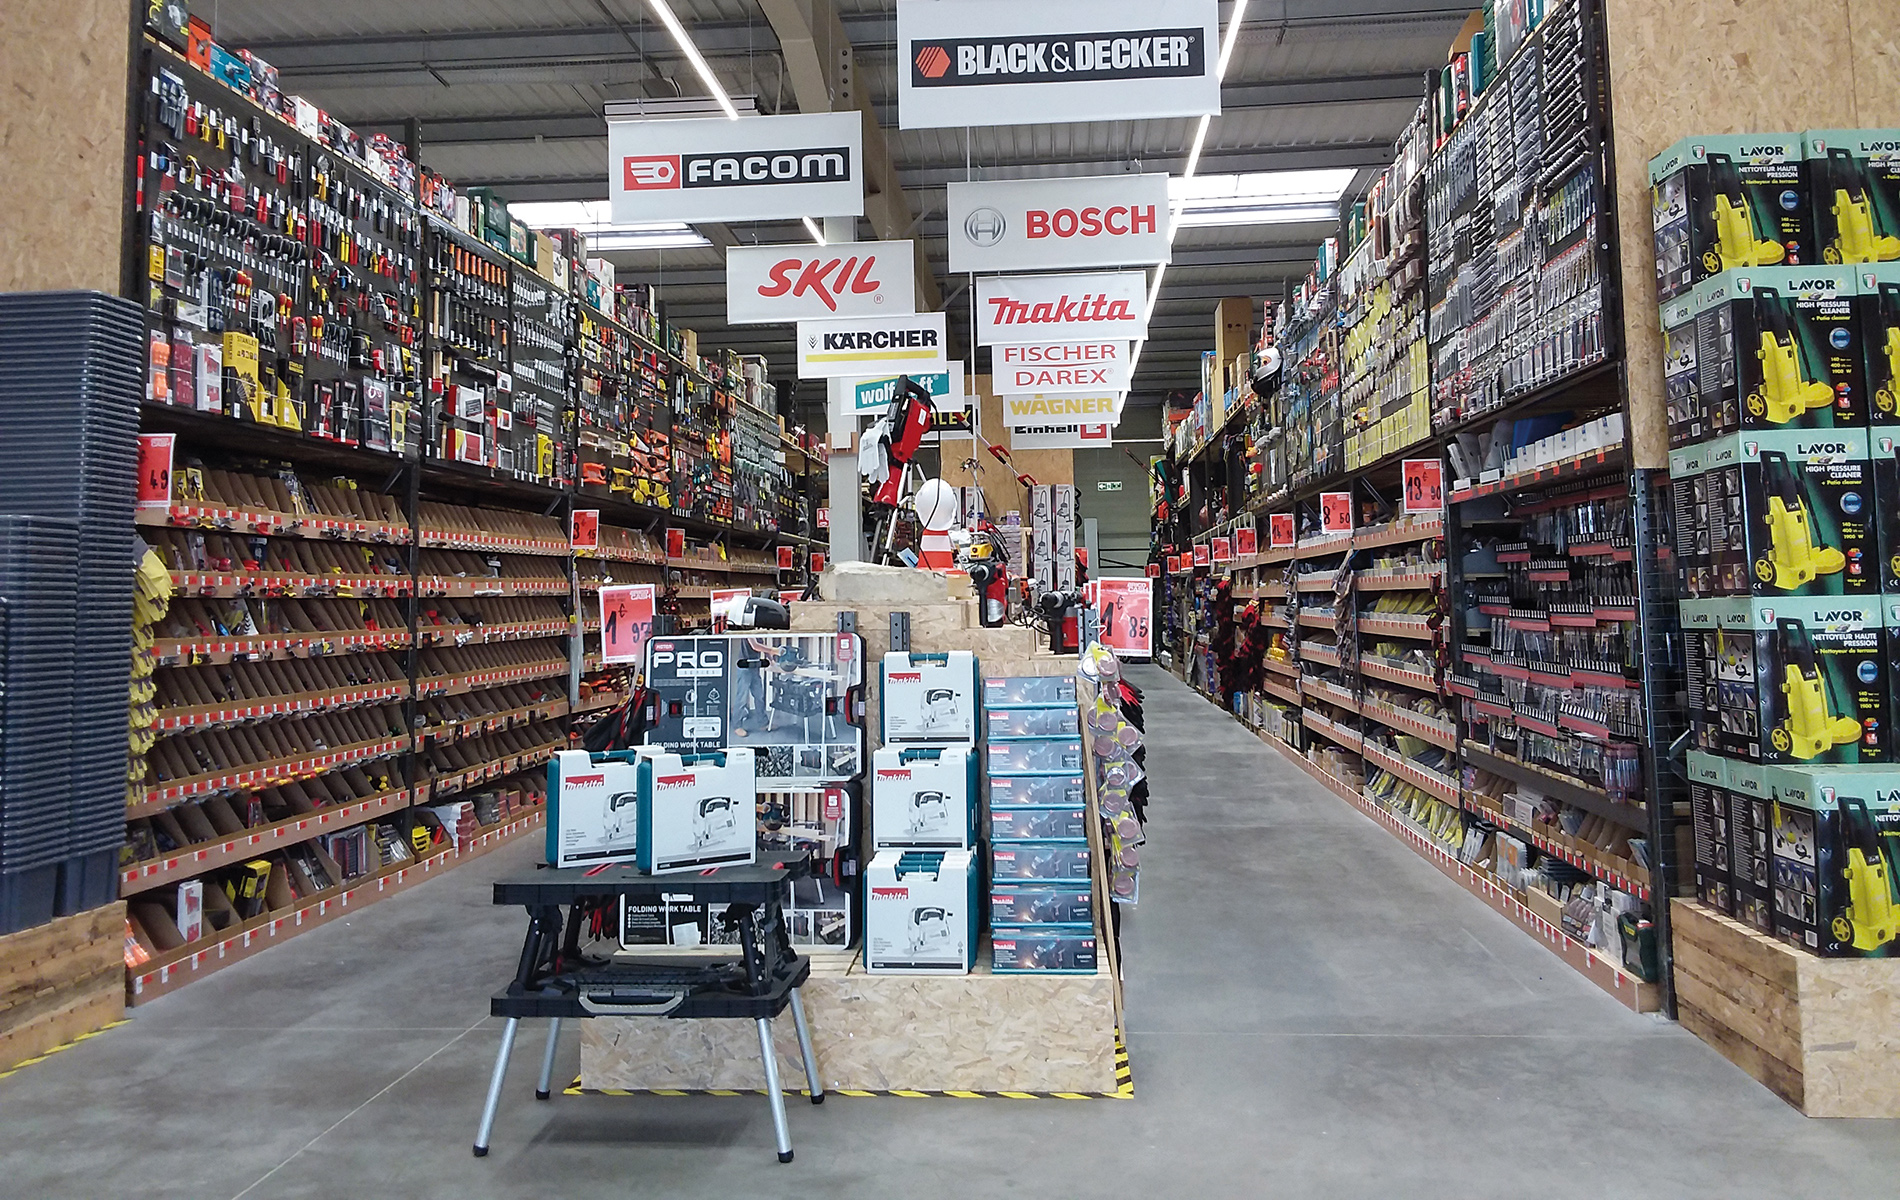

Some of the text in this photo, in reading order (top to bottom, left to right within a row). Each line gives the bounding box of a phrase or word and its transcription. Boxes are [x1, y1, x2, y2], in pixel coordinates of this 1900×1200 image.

[957, 36, 1189, 76] BLACK&DECKER
[1740, 146, 1784, 157] LAVOR
[688, 153, 844, 183] FACOM
[1026, 204, 1156, 239] BOSCH
[757, 255, 881, 313] SKIL
[1788, 279, 1836, 291] LAVOR
[823, 329, 938, 350] KÄRCHER
[1004, 344, 1117, 362] FISCHER
[1015, 368, 1107, 386] DAREX
[860, 376, 934, 405] wolfft
[1797, 443, 1846, 454] LAVOR
[1323, 505, 1331, 525] 8
[605, 611, 617, 644] 1
[618, 603, 628, 618] €
[1100, 595, 1148, 638] 1 € 85
[1814, 611, 1863, 622] LAVOR
[1811, 633, 1853, 641] NETTOYEUR
[653, 651, 723, 668] PRO
[628, 905, 657, 913] FOLDING
[680, 905, 702, 913] TABLE
